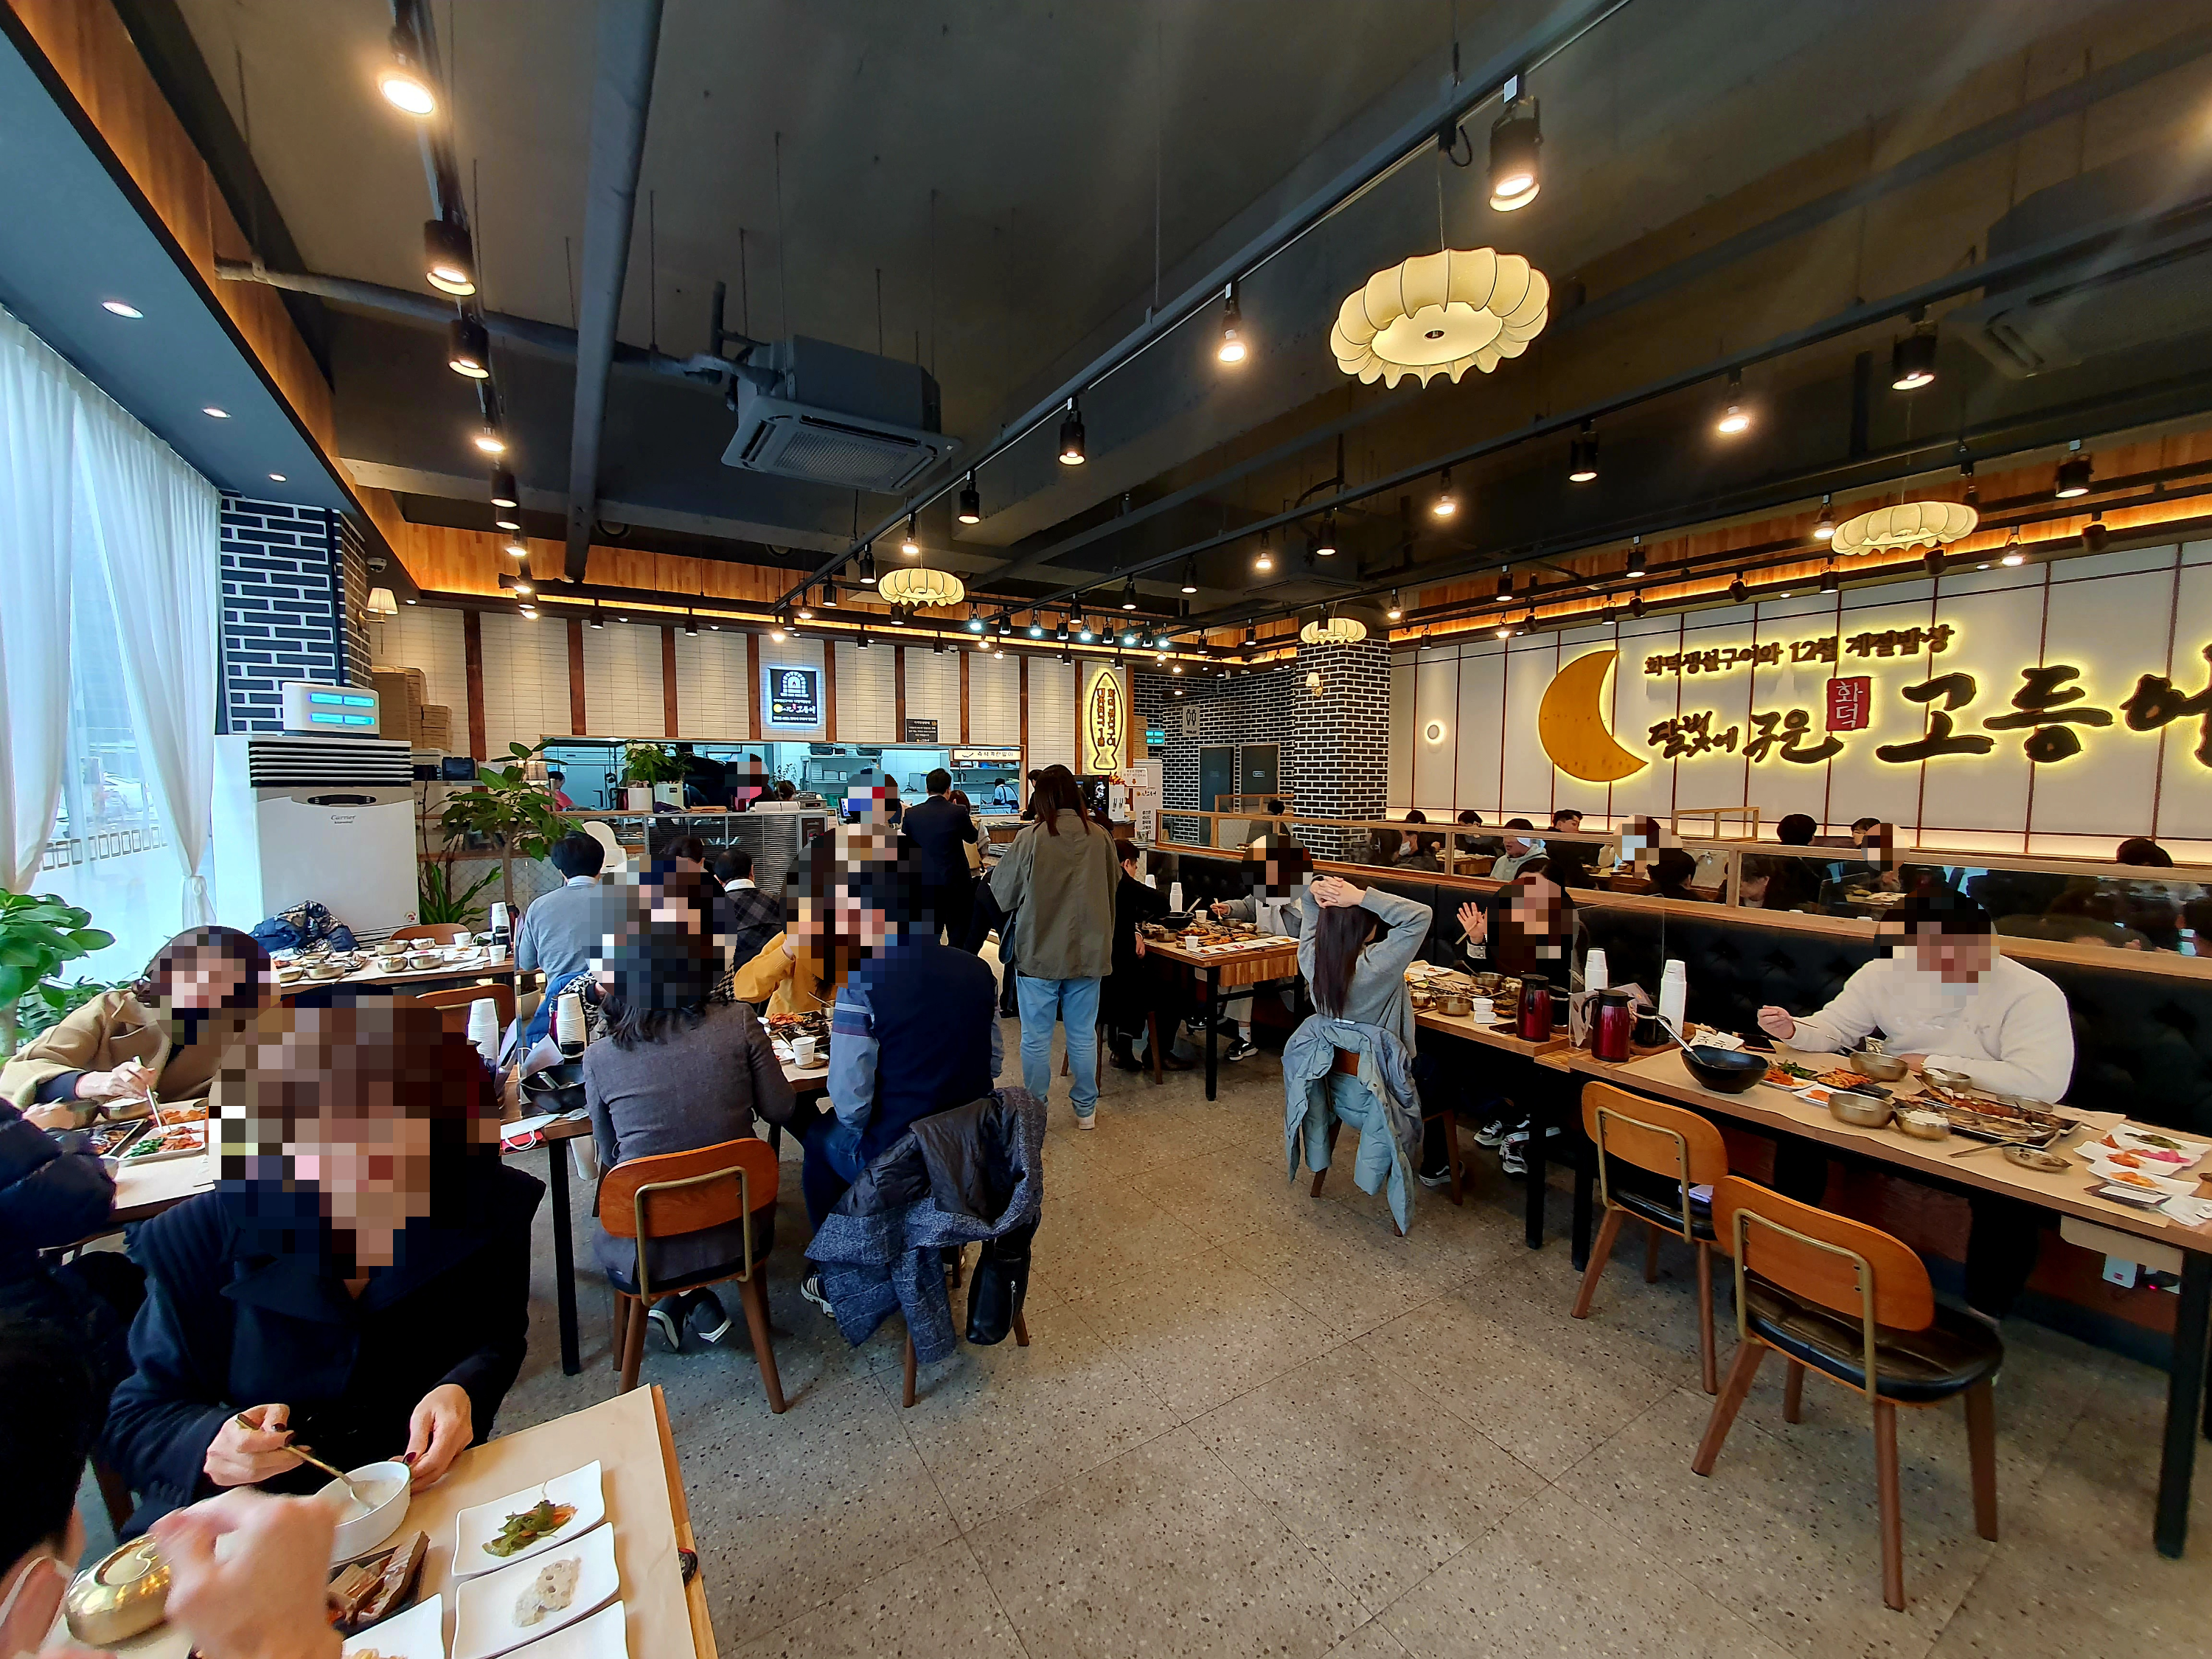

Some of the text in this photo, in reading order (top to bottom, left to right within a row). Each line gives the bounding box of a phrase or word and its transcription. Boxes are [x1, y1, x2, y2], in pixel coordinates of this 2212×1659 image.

[1644, 624, 1955, 675] 화덕생선구이와 12첩 계절밥상
[1835, 681, 1863, 728] 화덕
[1876, 644, 2212, 768] 고등어
[1648, 709, 1844, 764] 달빛에 구운
